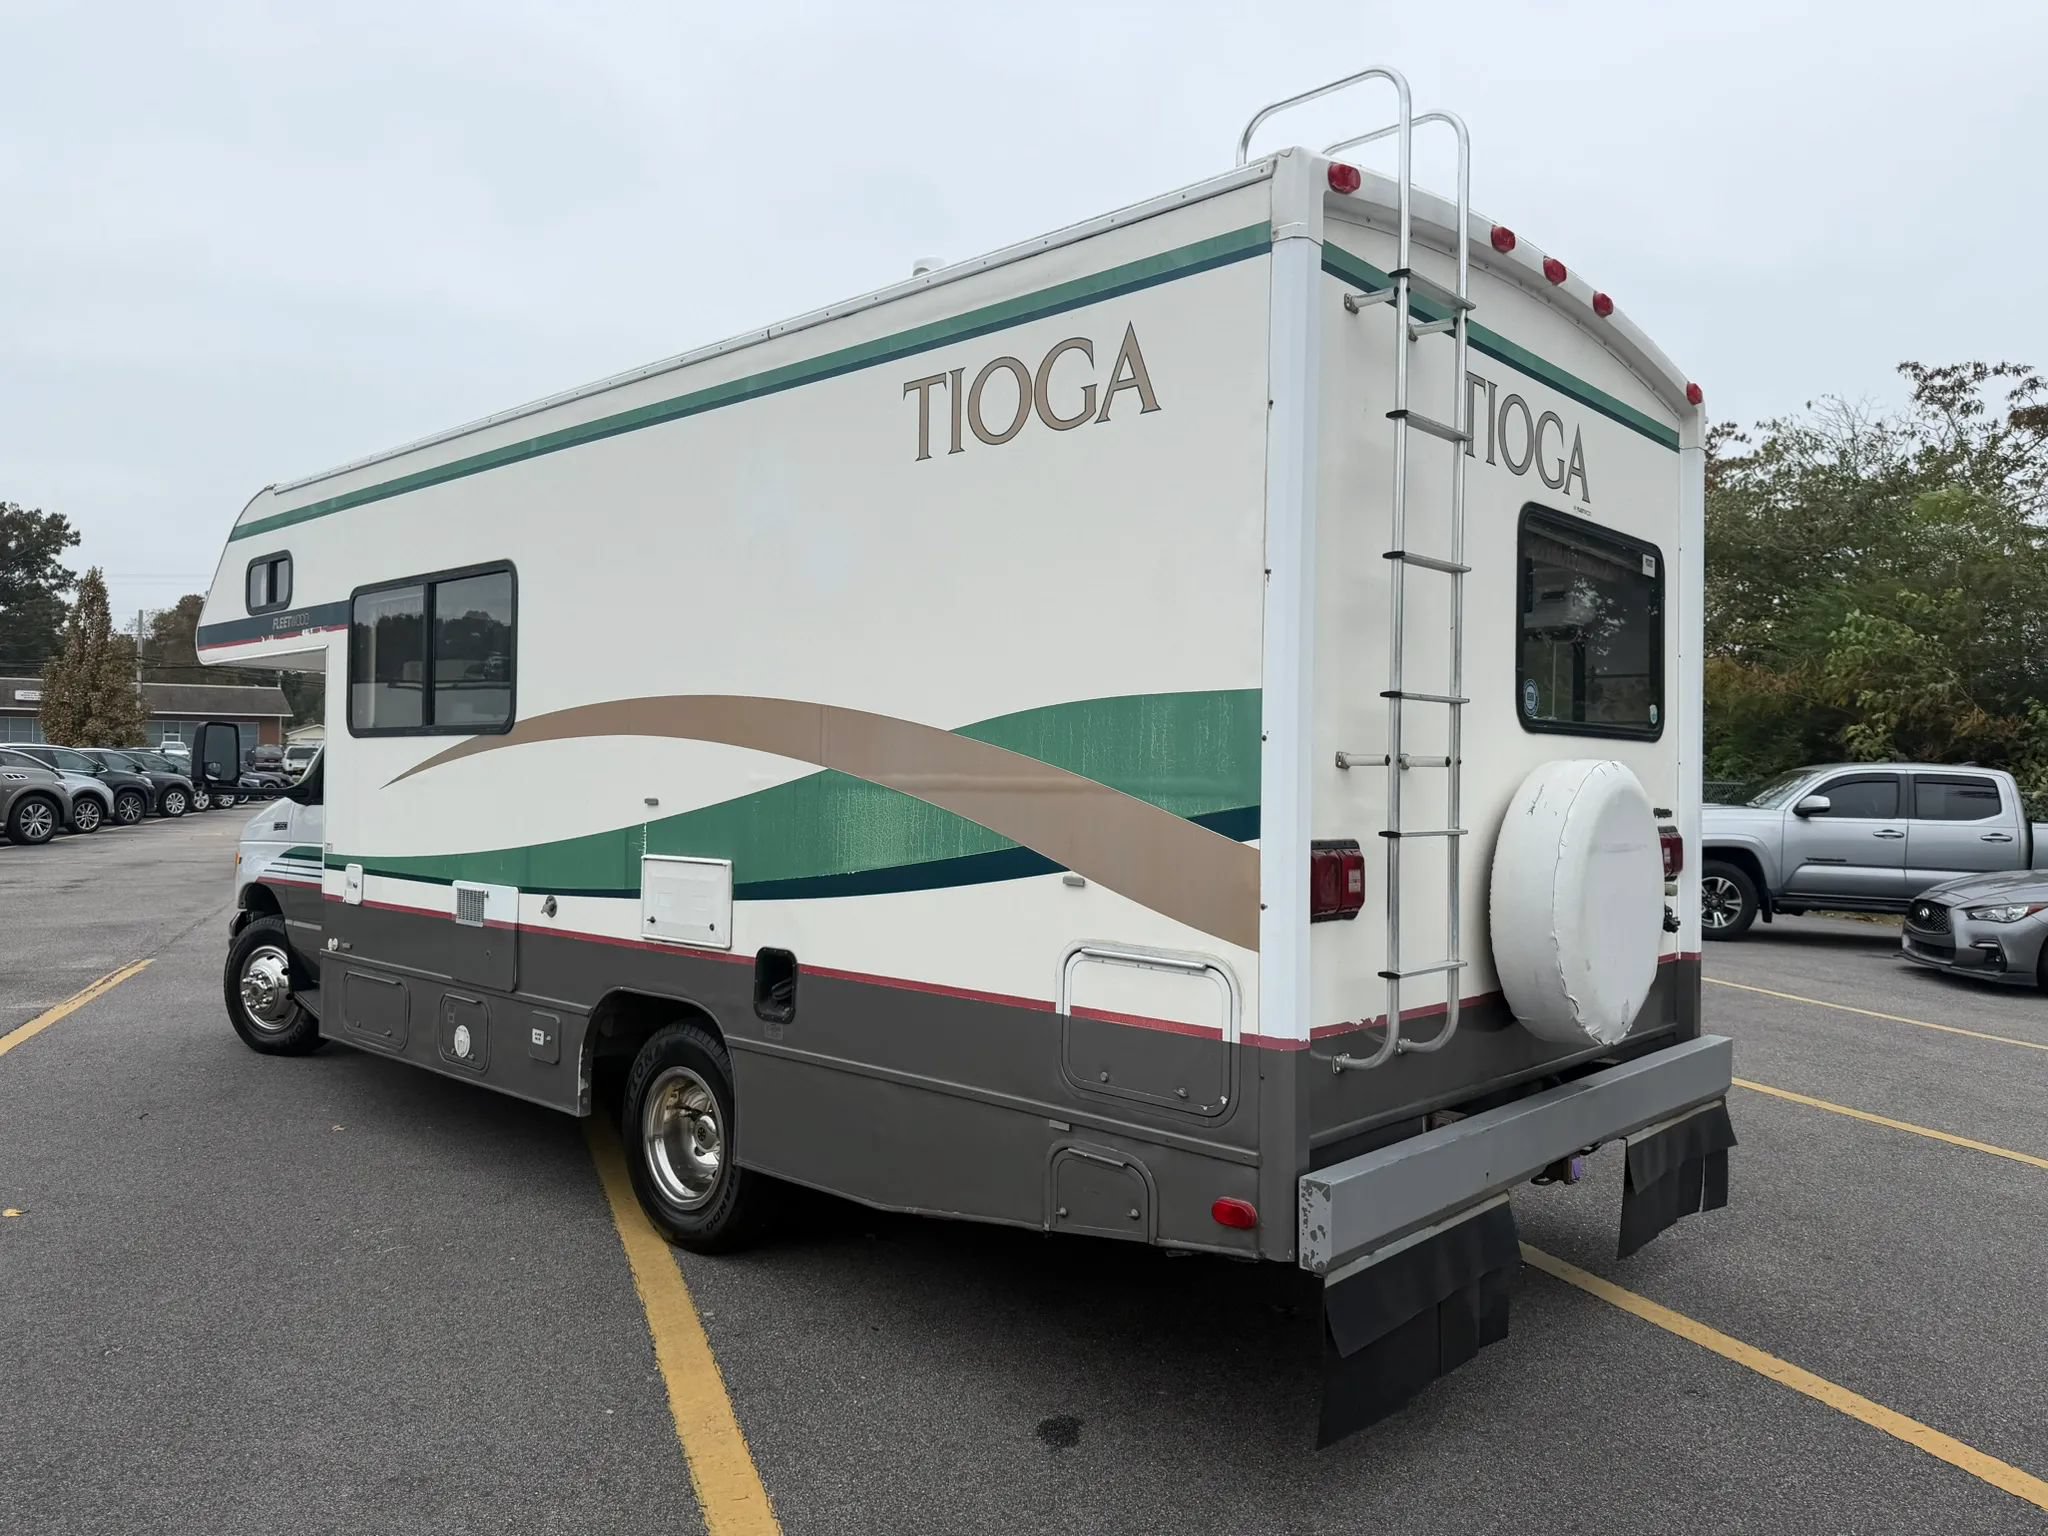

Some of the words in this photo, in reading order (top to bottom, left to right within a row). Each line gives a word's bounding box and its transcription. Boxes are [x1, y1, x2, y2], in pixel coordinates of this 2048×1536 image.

[903, 320, 1162, 462] TIOGA
[1465, 370, 1590, 504] TIOGA
[272, 612, 311, 630] FLEETWOOD
